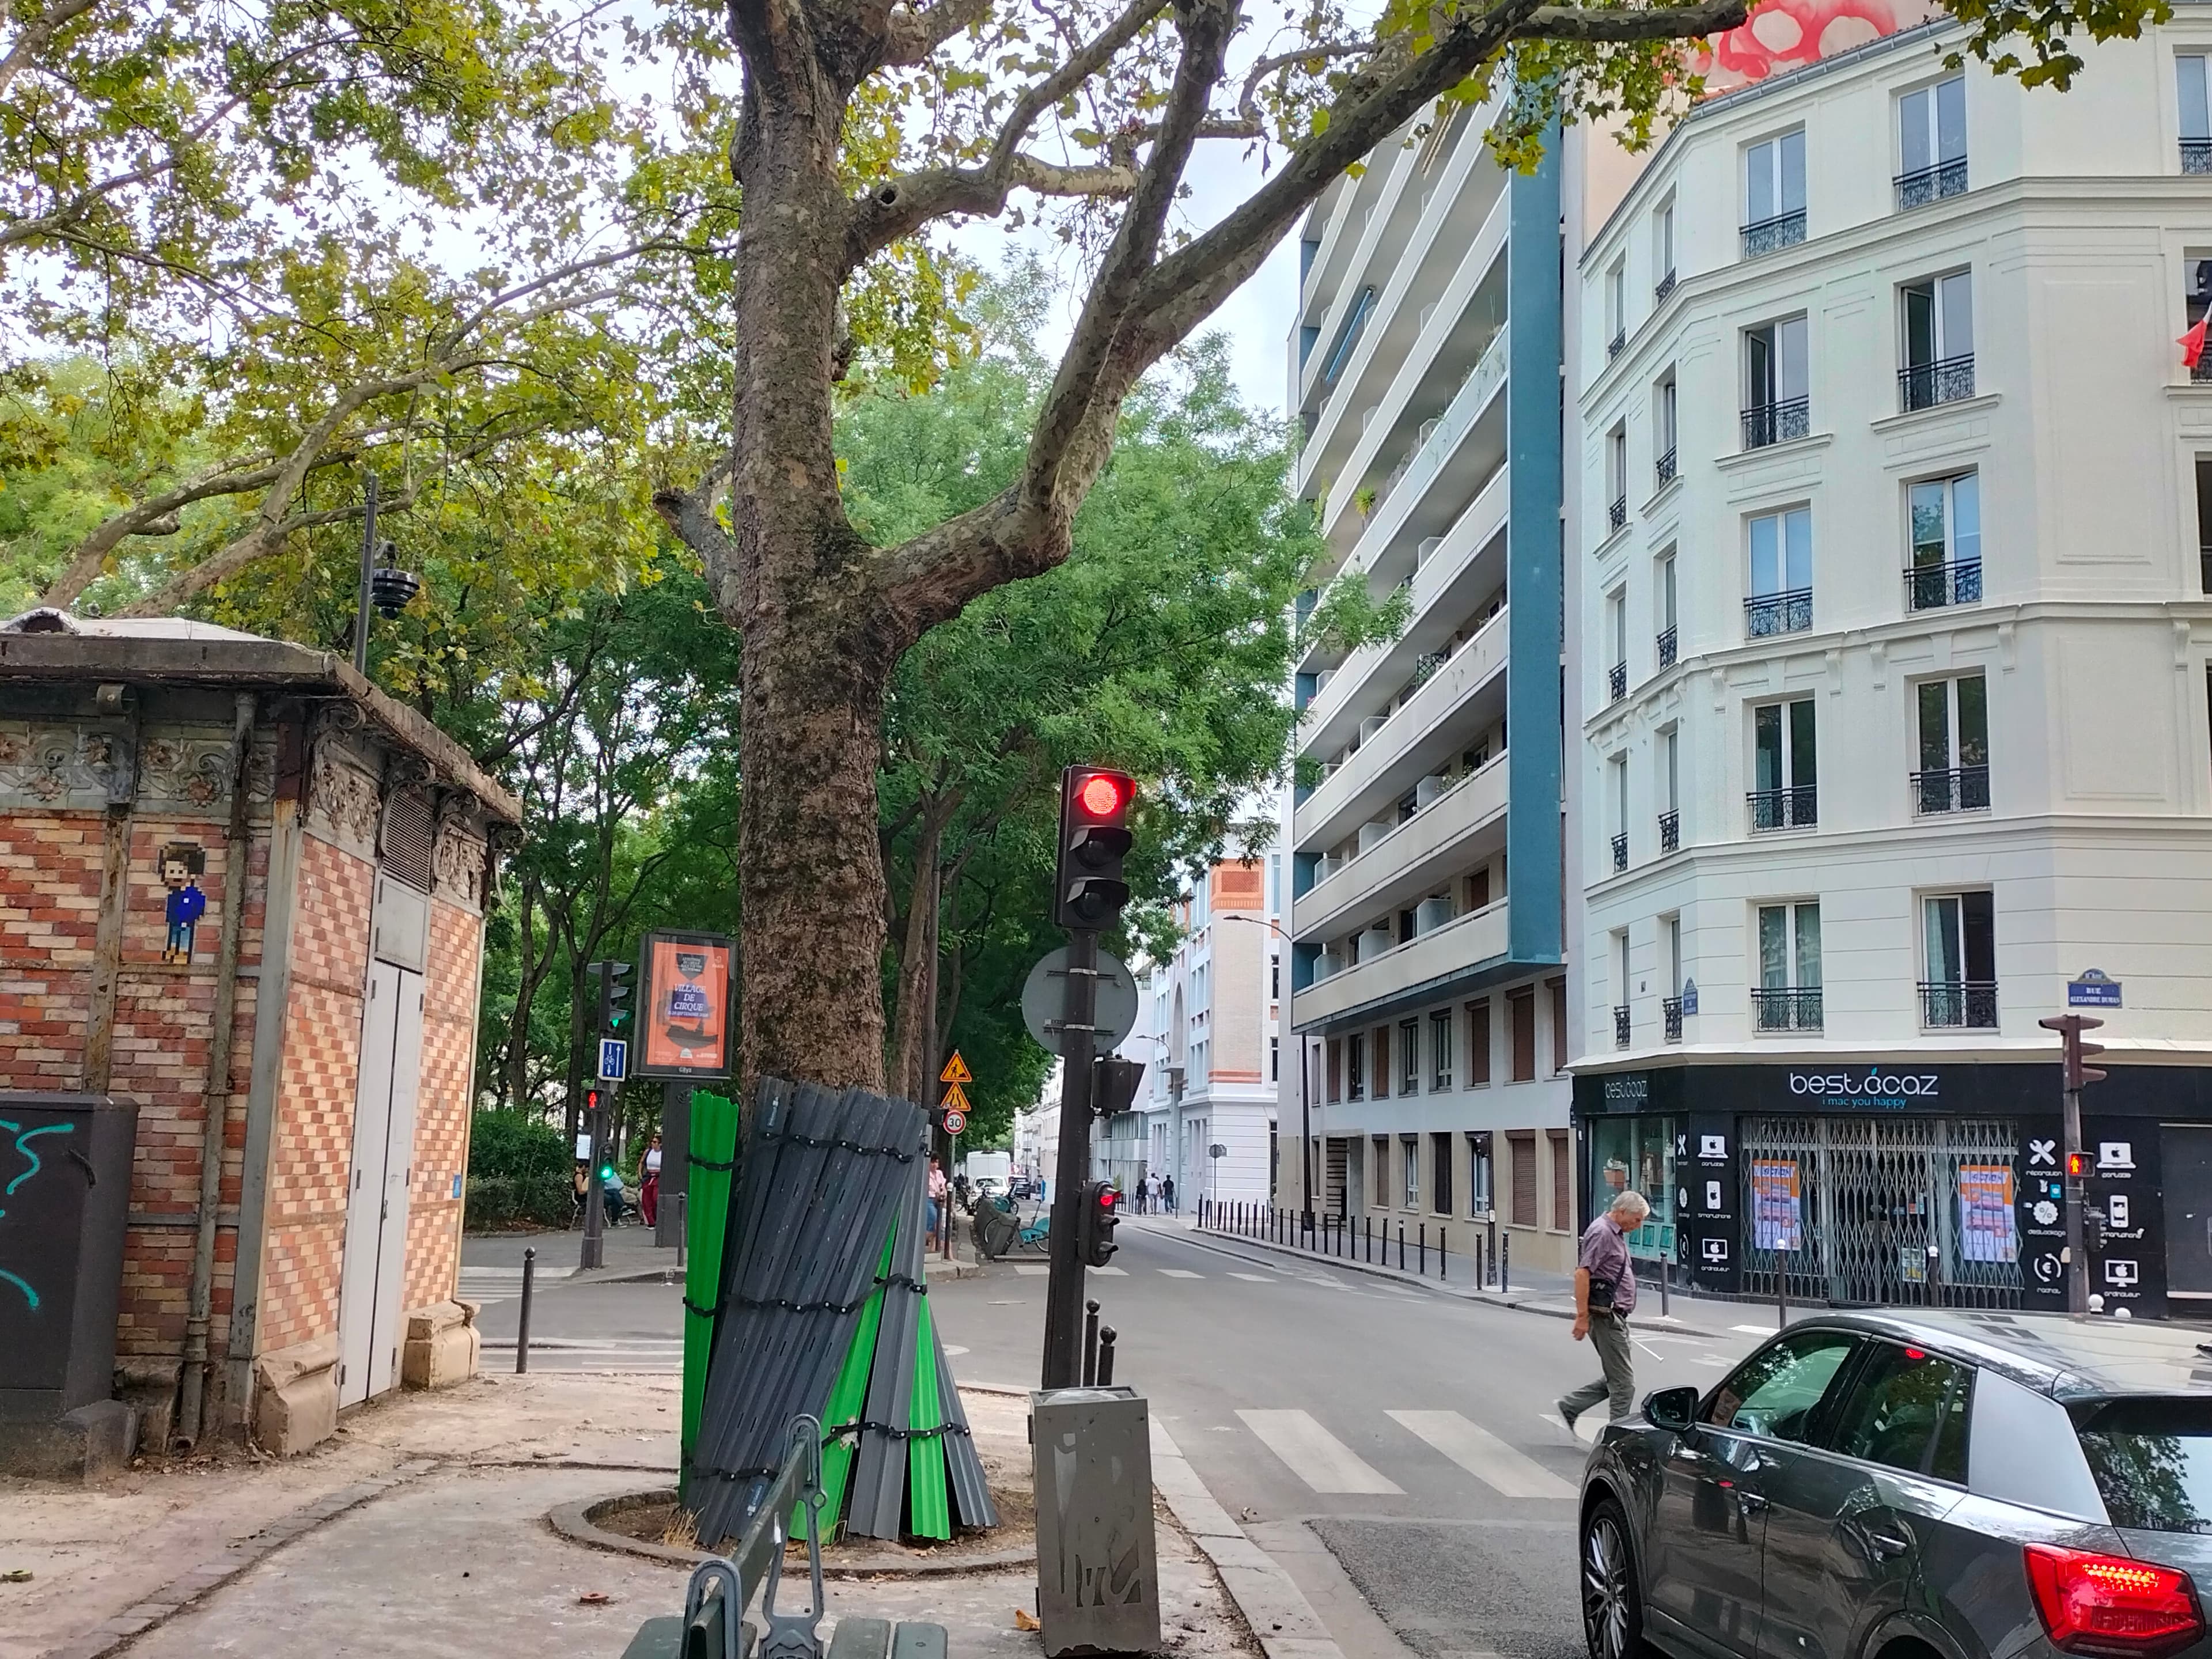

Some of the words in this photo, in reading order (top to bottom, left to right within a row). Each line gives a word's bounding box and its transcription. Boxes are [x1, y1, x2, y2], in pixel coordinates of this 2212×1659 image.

[675, 983, 706, 993] VILLAGE
[683, 993, 695, 1002] DE
[674, 1002, 704, 1012] CIRQUE
[1822, 1097, 1825, 1105] i
[1851, 1099, 1871, 1108] you
[1873, 1096, 1907, 1109] happy
[949, 1118, 961, 1127] 30
